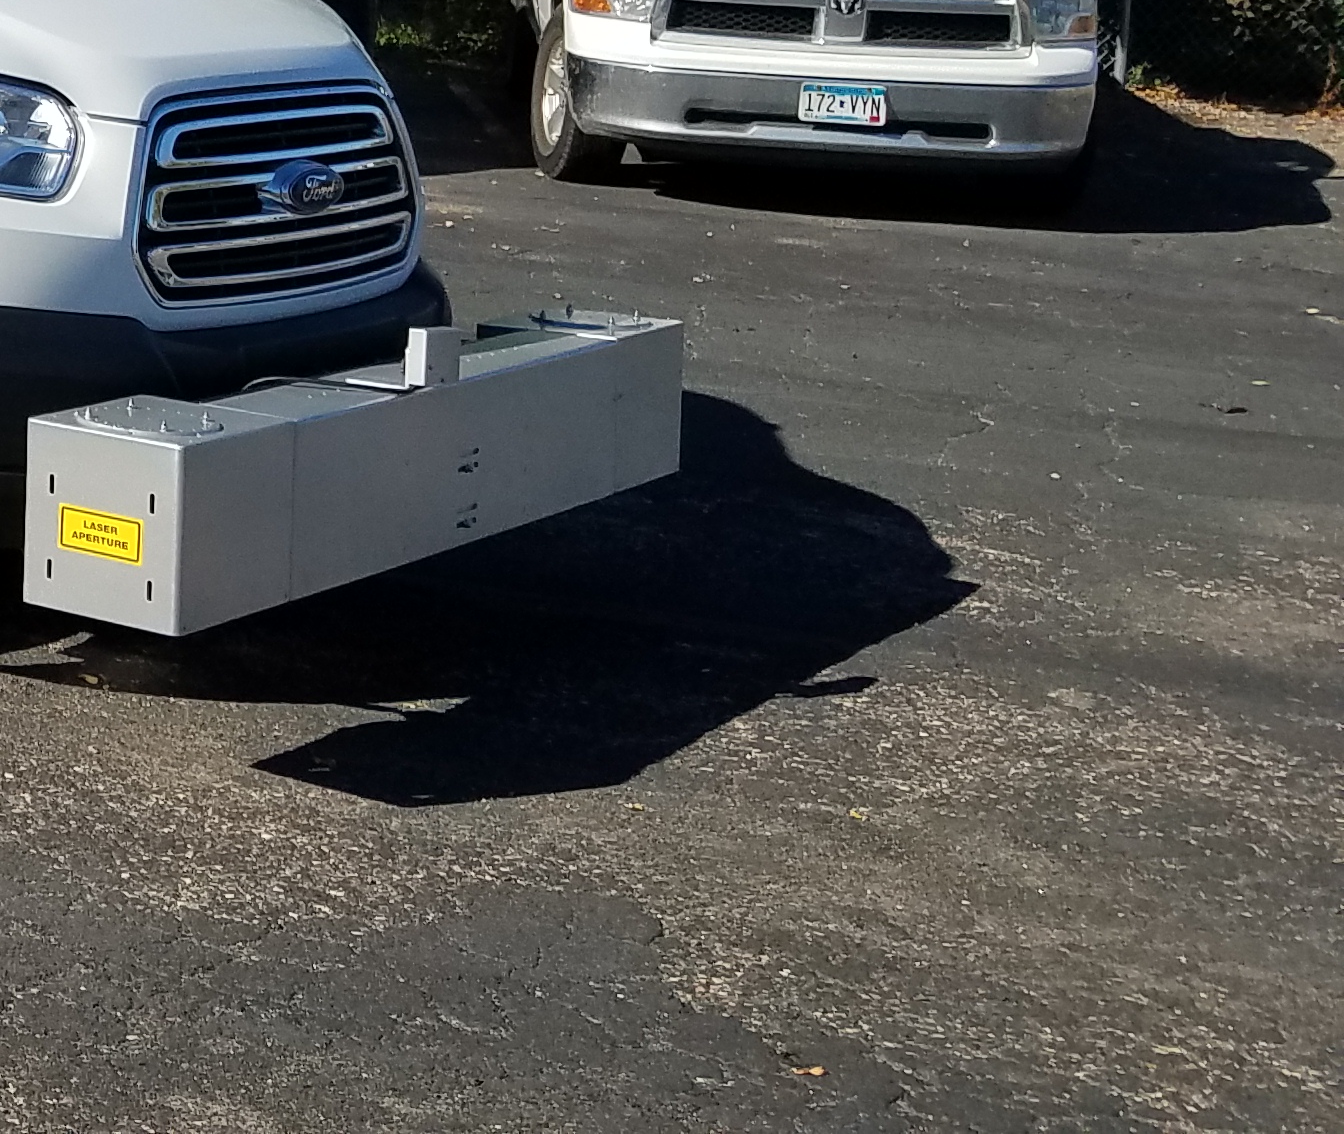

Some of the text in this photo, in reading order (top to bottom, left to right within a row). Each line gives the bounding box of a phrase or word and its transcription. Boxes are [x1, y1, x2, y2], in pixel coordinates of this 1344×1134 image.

[804, 93, 881, 118] 172 VYN
[302, 174, 337, 203] Ford
[83, 519, 118, 536] LASER
[71, 530, 129, 551] APERTURE
